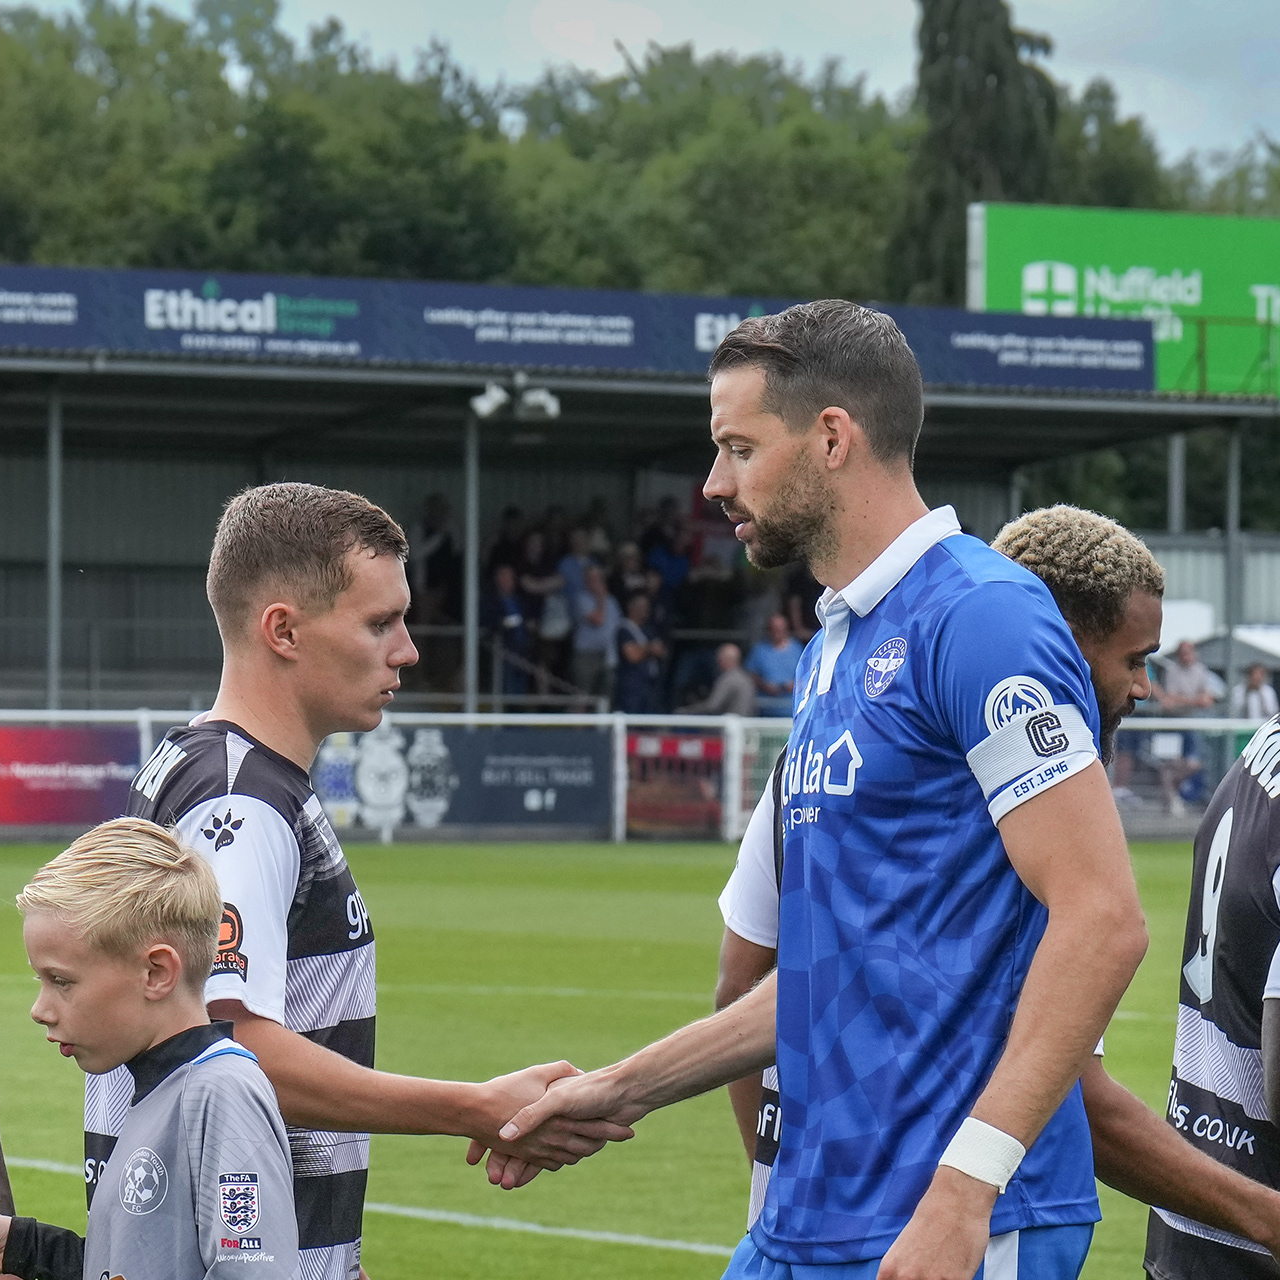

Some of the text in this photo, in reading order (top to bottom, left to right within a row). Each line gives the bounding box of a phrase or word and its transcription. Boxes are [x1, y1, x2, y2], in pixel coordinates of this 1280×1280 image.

[144, 279, 276, 333] Ethical
[1083, 264, 1202, 306] Nuffield
[1025, 711, 1069, 758] C
[1182, 806, 1234, 1004] 9
[132, 1204, 142, 1213] FC
